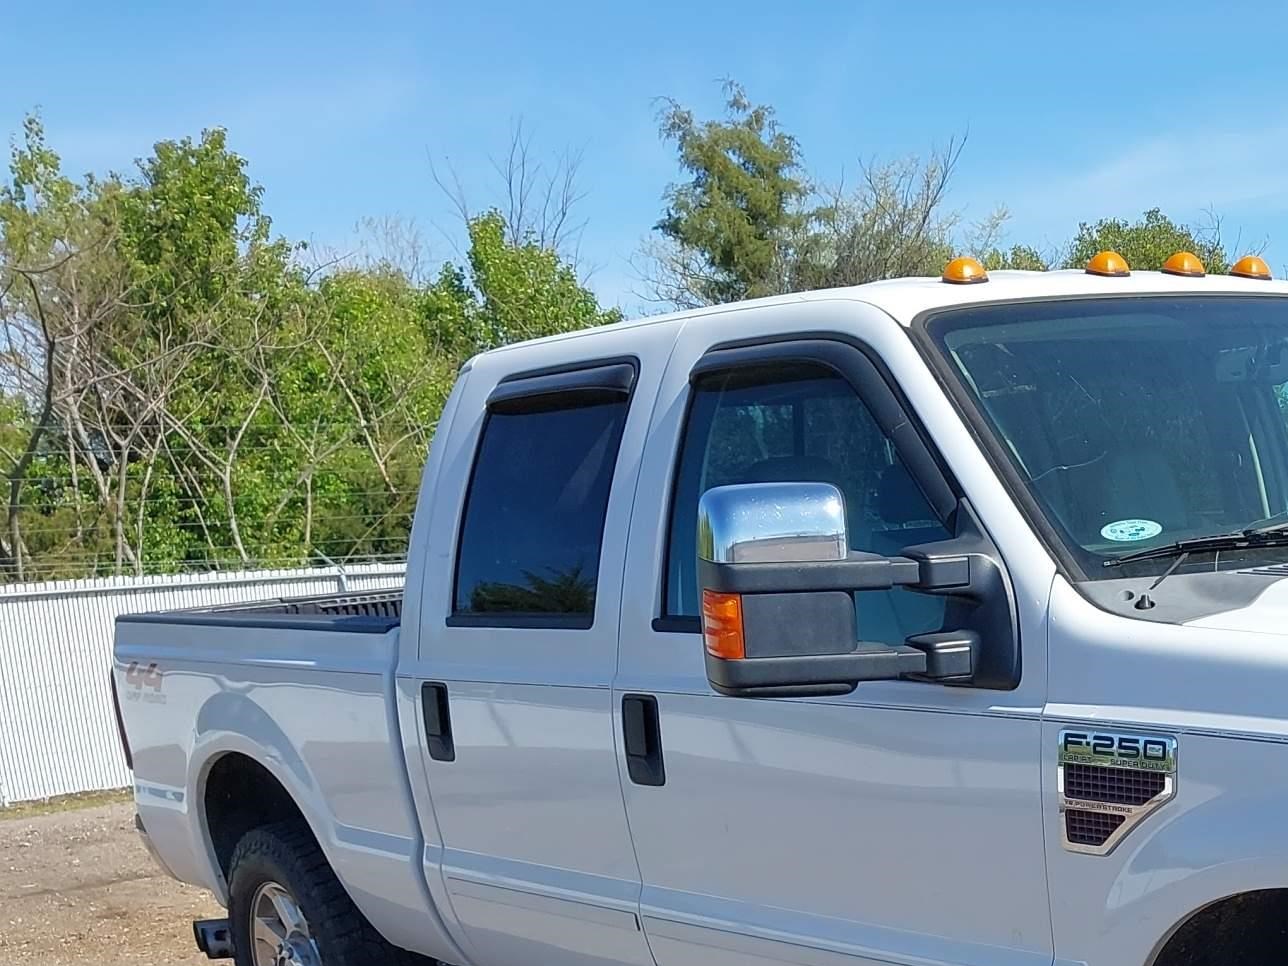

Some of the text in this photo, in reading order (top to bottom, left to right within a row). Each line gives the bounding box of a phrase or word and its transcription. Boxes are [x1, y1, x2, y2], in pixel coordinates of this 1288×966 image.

[1064, 732, 1167, 762] F-250
[1110, 758, 1165, 770] SUPER DUTY
